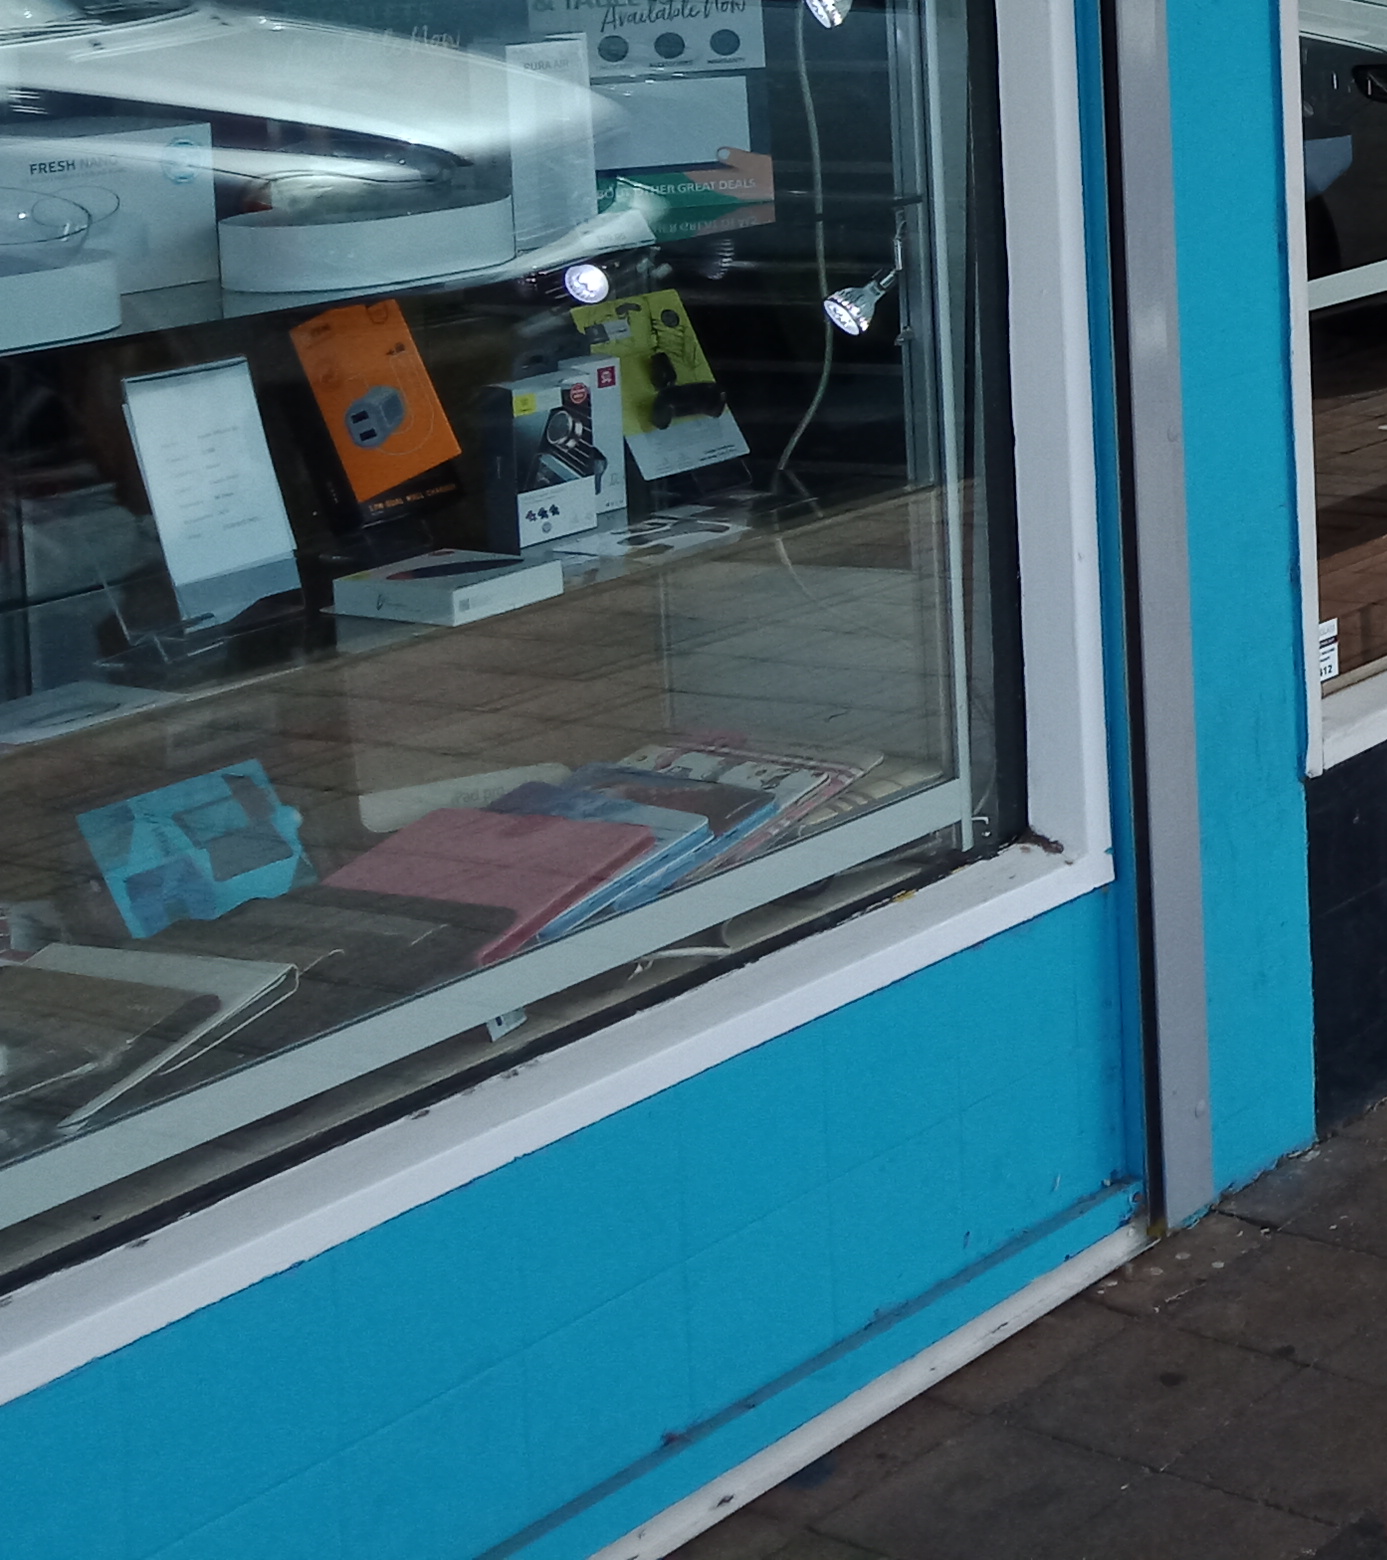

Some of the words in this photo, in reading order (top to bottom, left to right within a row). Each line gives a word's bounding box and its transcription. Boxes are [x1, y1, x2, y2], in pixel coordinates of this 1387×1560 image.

[29, 160, 76, 175] FRESH
[677, 182, 716, 194] GREAT
[718, 178, 757, 190] DEALS
